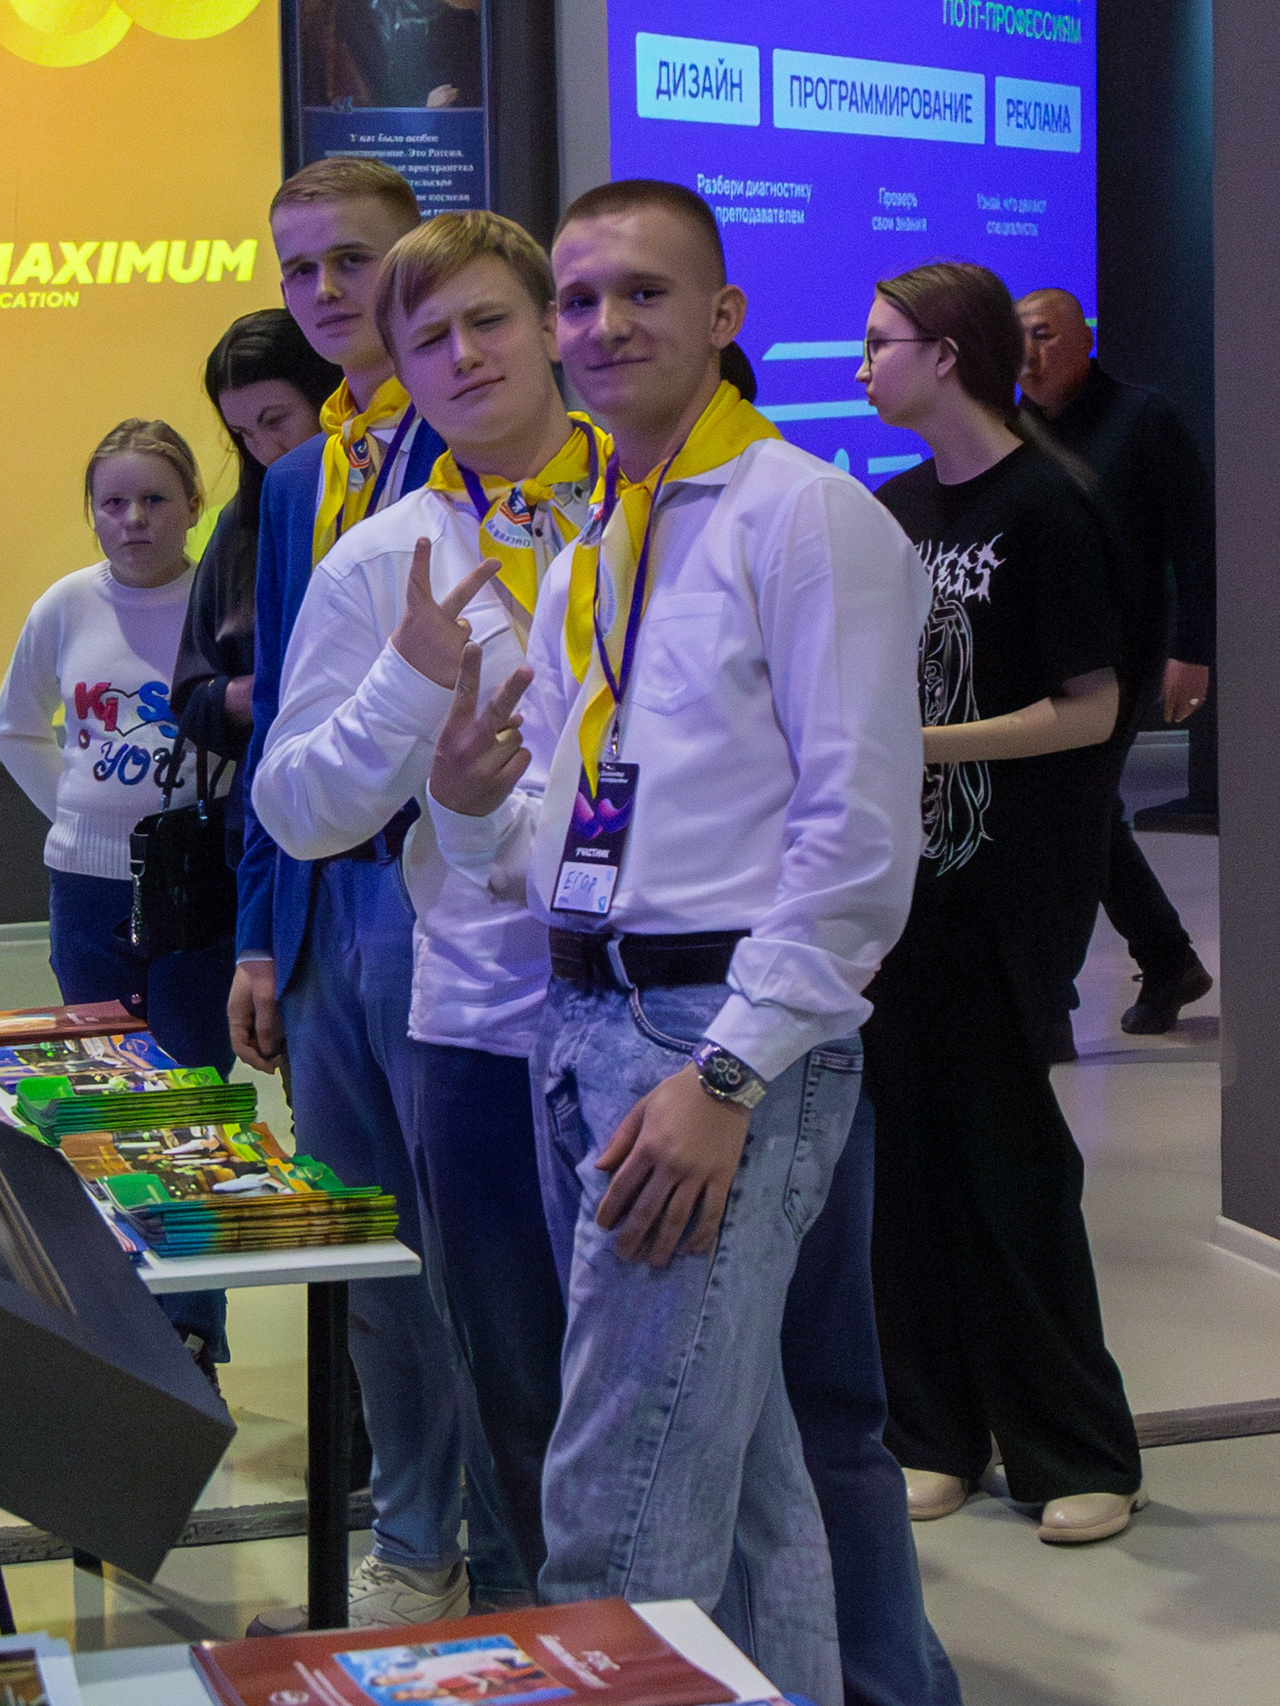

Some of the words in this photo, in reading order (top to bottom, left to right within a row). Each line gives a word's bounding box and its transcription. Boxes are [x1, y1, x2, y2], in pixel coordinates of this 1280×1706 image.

[656, 58, 744, 103] ДИЗАЙН
[789, 75, 973, 125] ПРОГРАММИРОВАНИЕ
[1006, 98, 1072, 134] РЕКЛАМА
[697, 173, 744, 200] Разбери
[746, 180, 812, 205] диагностику
